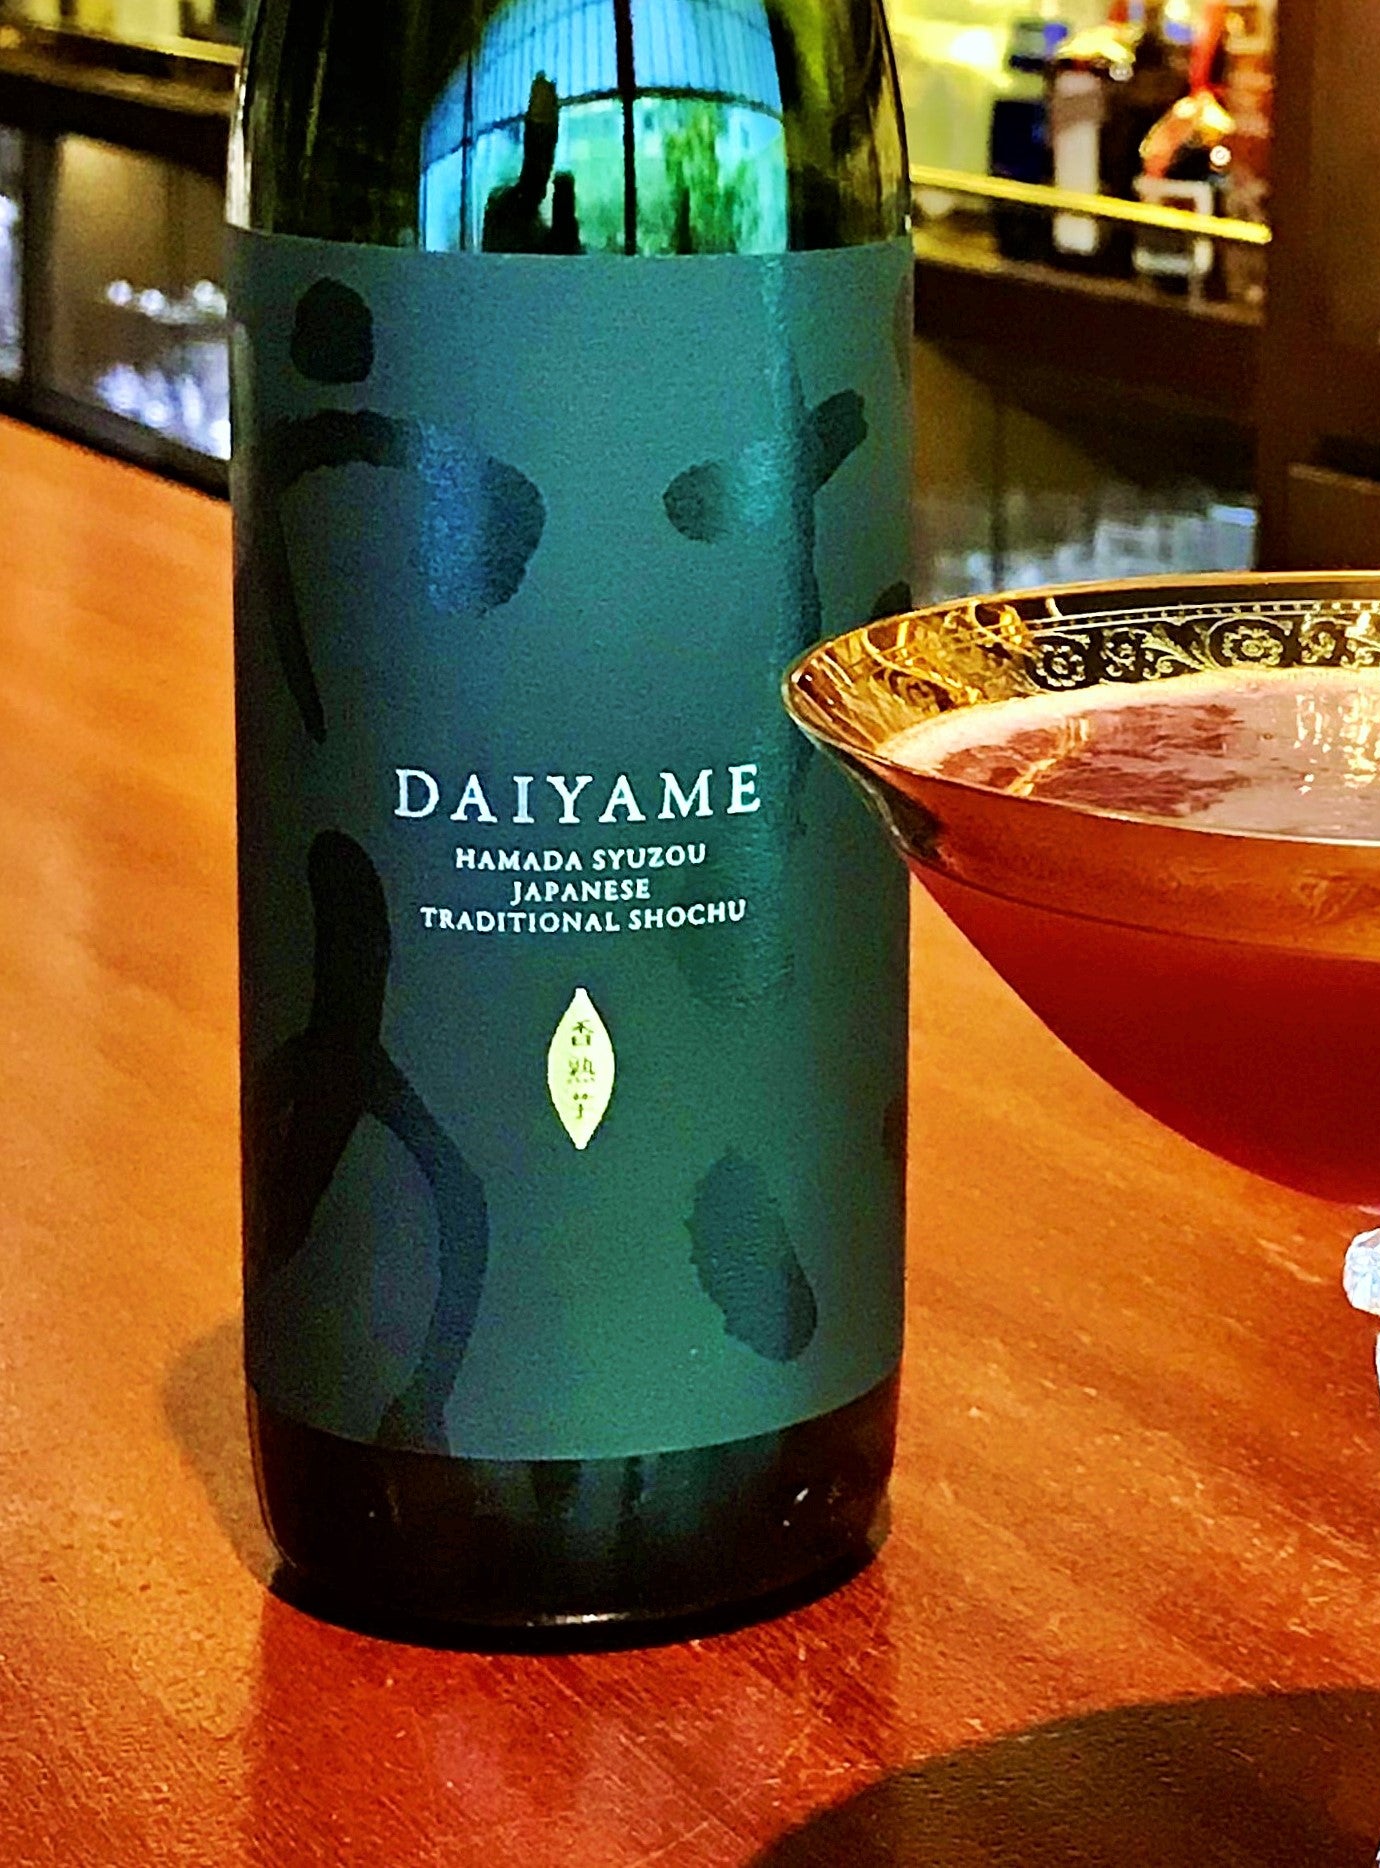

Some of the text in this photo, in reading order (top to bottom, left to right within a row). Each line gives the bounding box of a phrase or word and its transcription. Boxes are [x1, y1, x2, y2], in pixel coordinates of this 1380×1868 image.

[393, 763, 762, 824] DAIYAME
[455, 843, 707, 872] HAMADA SYUZOU
[510, 878, 652, 906] JAPANESE
[420, 898, 747, 933] TRADITIONAL SHOCHU
